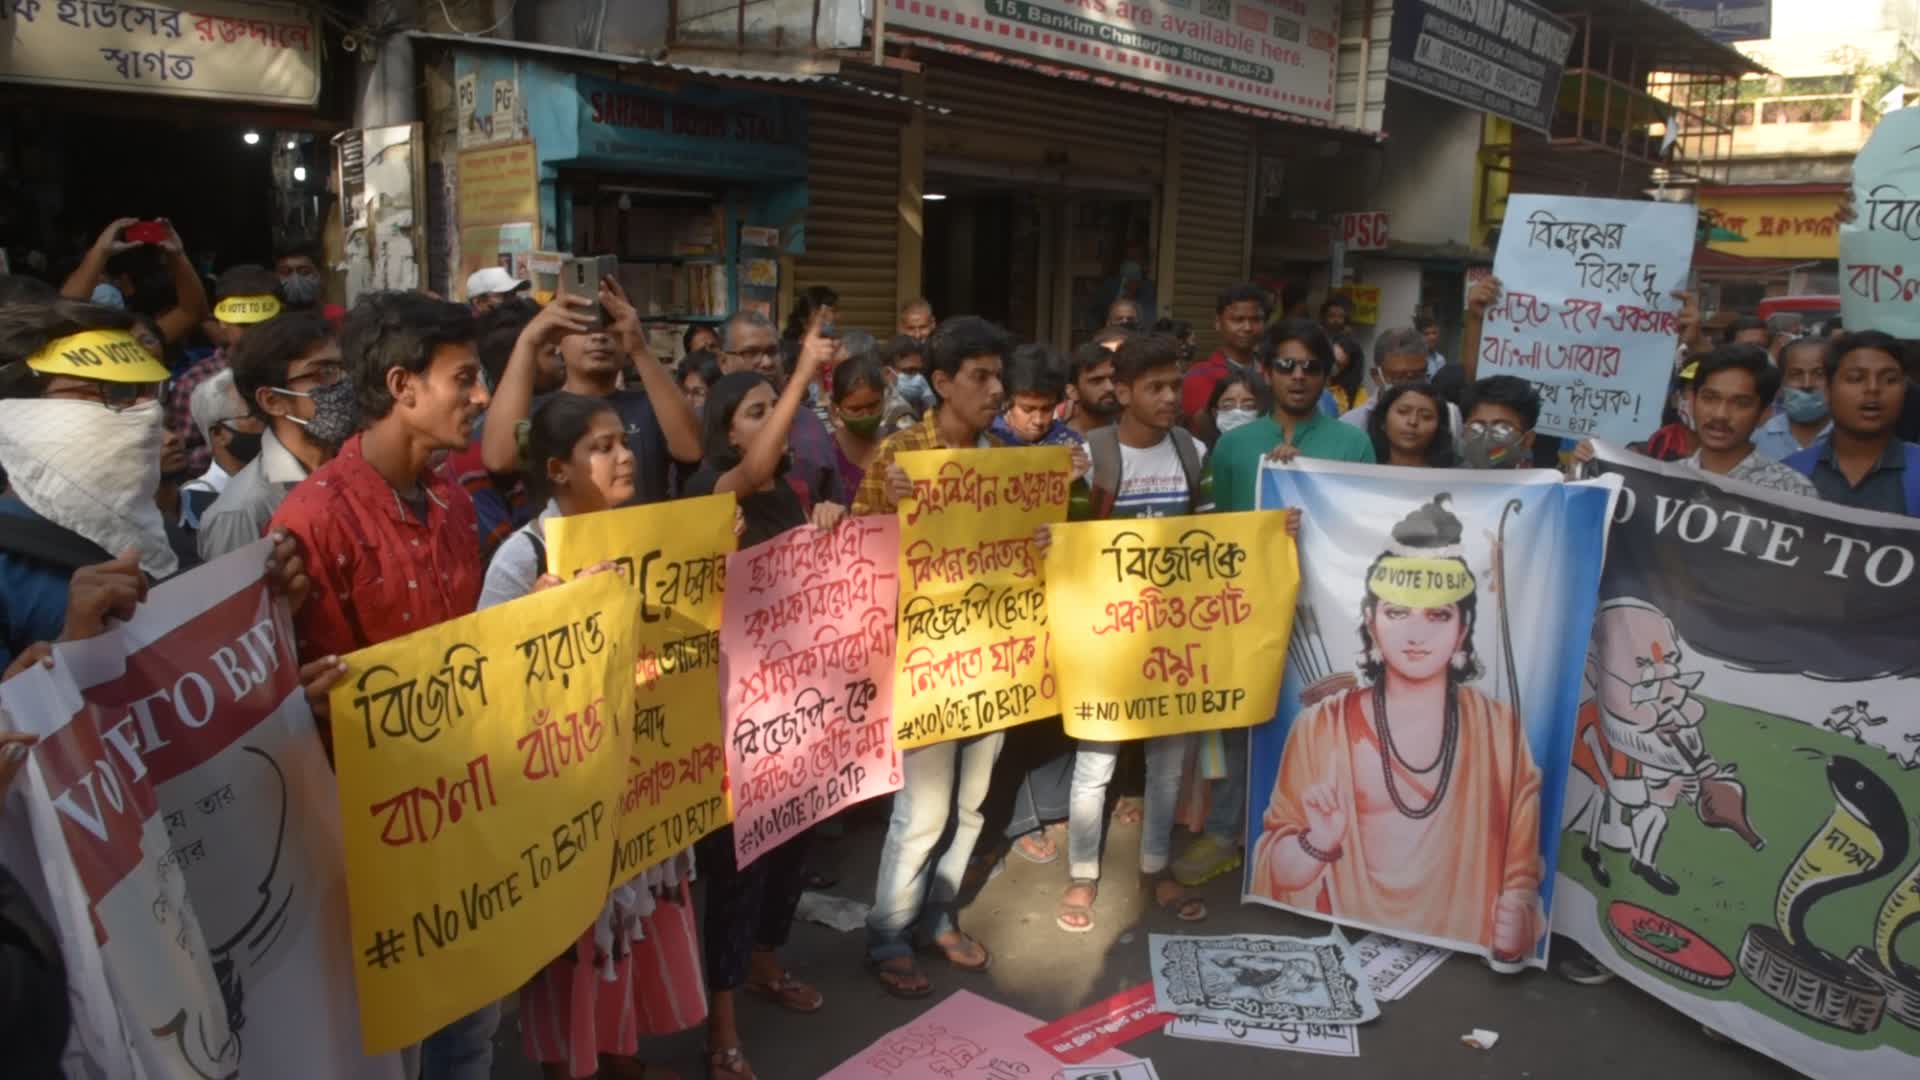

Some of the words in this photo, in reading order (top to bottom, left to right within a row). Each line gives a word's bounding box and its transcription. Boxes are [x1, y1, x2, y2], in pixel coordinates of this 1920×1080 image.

[57, 0, 183, 38] হাউসের
[187, 11, 311, 51] রক্তদানে
[1028, 5, 1096, 36] Bankim
[1099, 25, 1178, 58] Chatterjee
[1183, 42, 1228, 73] Street,
[1116, 2, 1152, 25] are
[1161, 13, 1255, 51] available
[1261, 39, 1306, 67] here.
[99, 48, 195, 80] স্বাগত
[495, 86, 513, 110] PG
[1526, 210, 1627, 254] বিদ্বেষের
[61, 347, 103, 368] NO
[104, 341, 145, 365] VOTE
[1101, 529, 1247, 587] বিজেপিকে
[1655, 495, 1804, 567] VOTE
[1822, 531, 1914, 587] TO
[1390, 568, 1422, 589] VOTE
[1426, 570, 1444, 590] TO
[1446, 572, 1468, 590] BJP
[1188, 582, 1251, 632] ভোট
[209, 618, 280, 703] BJP
[354, 643, 489, 749] বিজেপি
[996, 683, 1037, 720] BJP
[1074, 701, 1120, 722] #NO
[1124, 695, 1169, 722] VOTE
[1175, 692, 1197, 715] TO
[1202, 687, 1247, 714] BJP
[370, 753, 497, 847] বাংলা
[826, 762, 867, 807] BJP
[552, 801, 604, 872] BJP
[660, 813, 683, 849] TO
[685, 796, 723, 838] BJP
